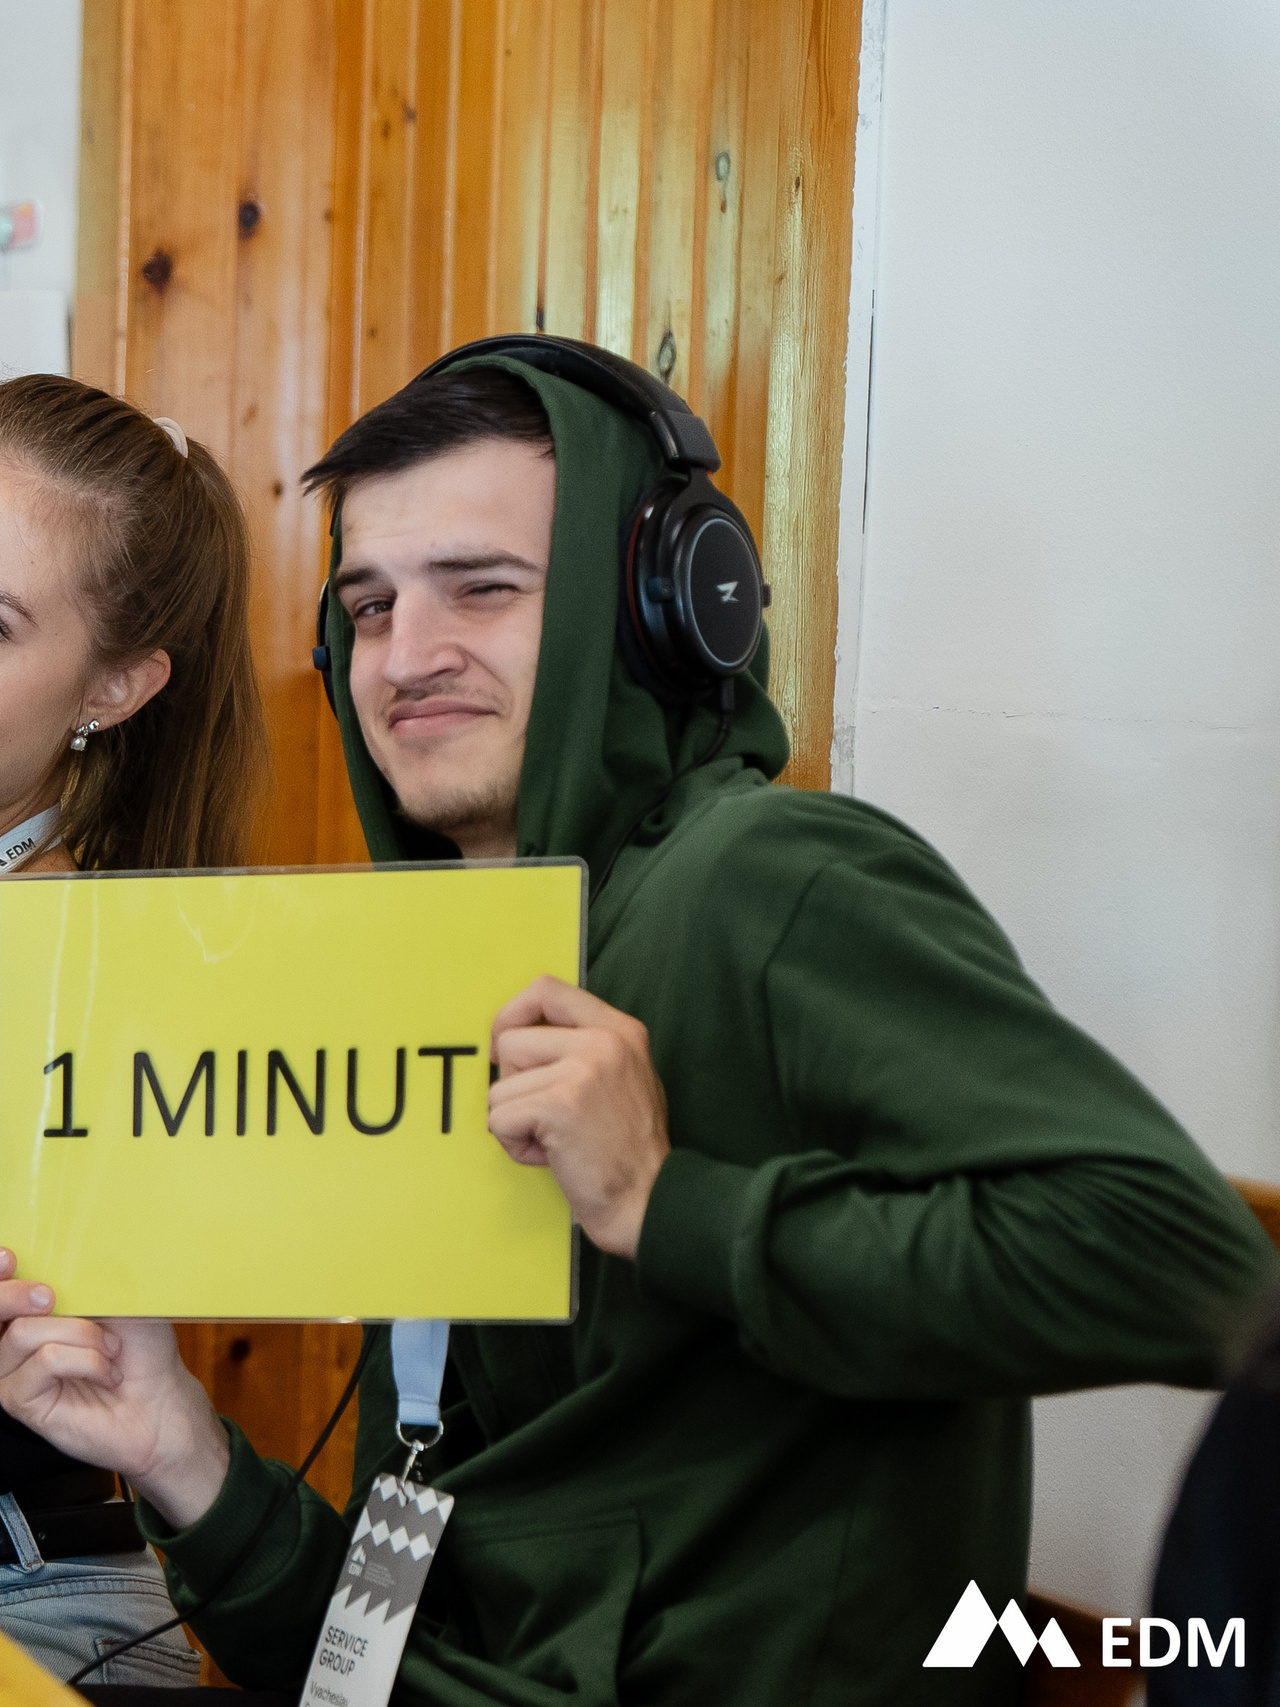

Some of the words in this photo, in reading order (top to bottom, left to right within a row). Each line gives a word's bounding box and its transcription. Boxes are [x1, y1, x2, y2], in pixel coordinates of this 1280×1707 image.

[6, 837, 36, 860] EDM
[43, 1052, 88, 1137] 1
[133, 1046, 500, 1137] MINUT
[325, 1625, 369, 1657] SERVICE
[319, 1648, 356, 1677] GROUP
